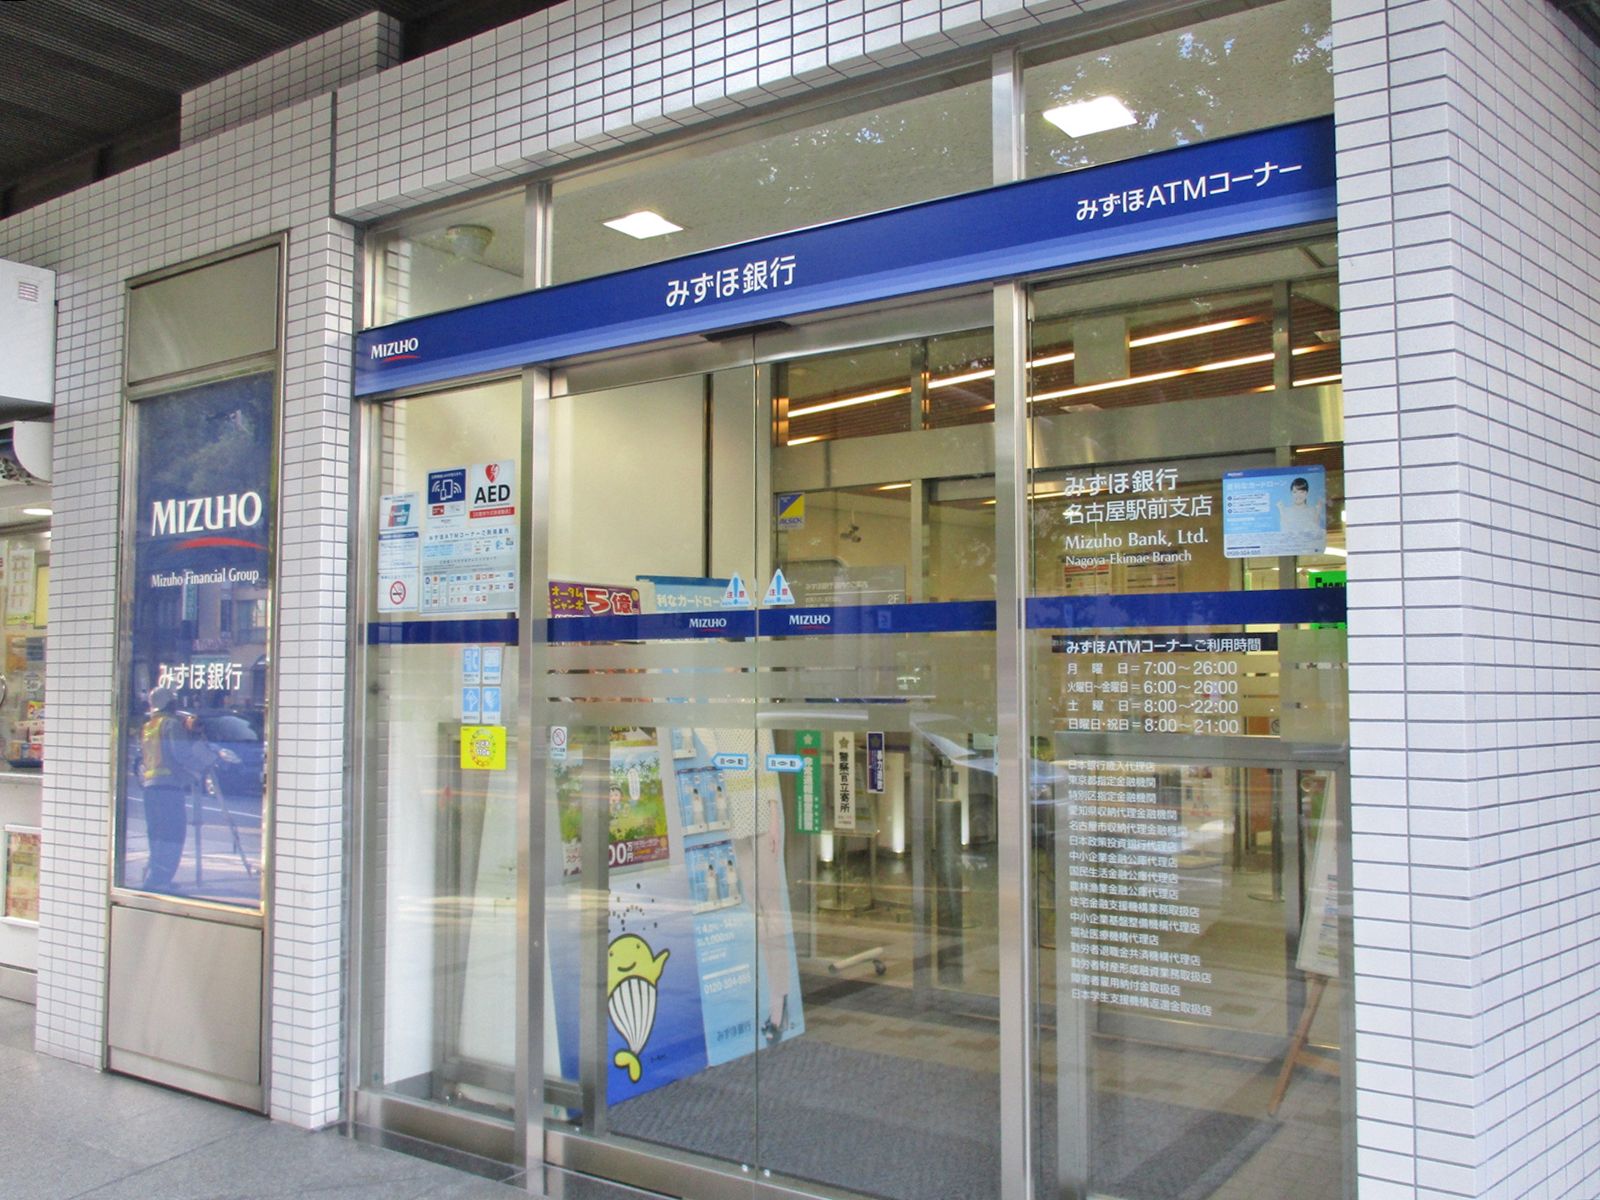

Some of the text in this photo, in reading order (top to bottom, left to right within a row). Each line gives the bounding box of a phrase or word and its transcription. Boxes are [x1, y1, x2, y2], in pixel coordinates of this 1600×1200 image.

[1075, 161, 1303, 221] みずほATMコーナー
[665, 254, 797, 308] みずほ銀行
[370, 337, 419, 360] MIZUHO
[474, 484, 511, 504] AED
[1064, 468, 1179, 497] みずほ銀行
[151, 491, 263, 537] MIZUHO
[1063, 494, 1213, 525] 名古屋駅前支店
[1065, 533, 1123, 550] Mizuho
[1128, 529, 1173, 547] Bank,
[1178, 527, 1209, 545] Ltd.
[1065, 549, 1192, 570] Nagoya-Ekimae Branch
[151, 567, 260, 588] Mizuho Financial Group
[584, 587, 633, 616] 5億
[688, 617, 727, 629] MIZUHO
[788, 614, 831, 625] MIZUHO
[157, 662, 243, 691] みずほ銀行
